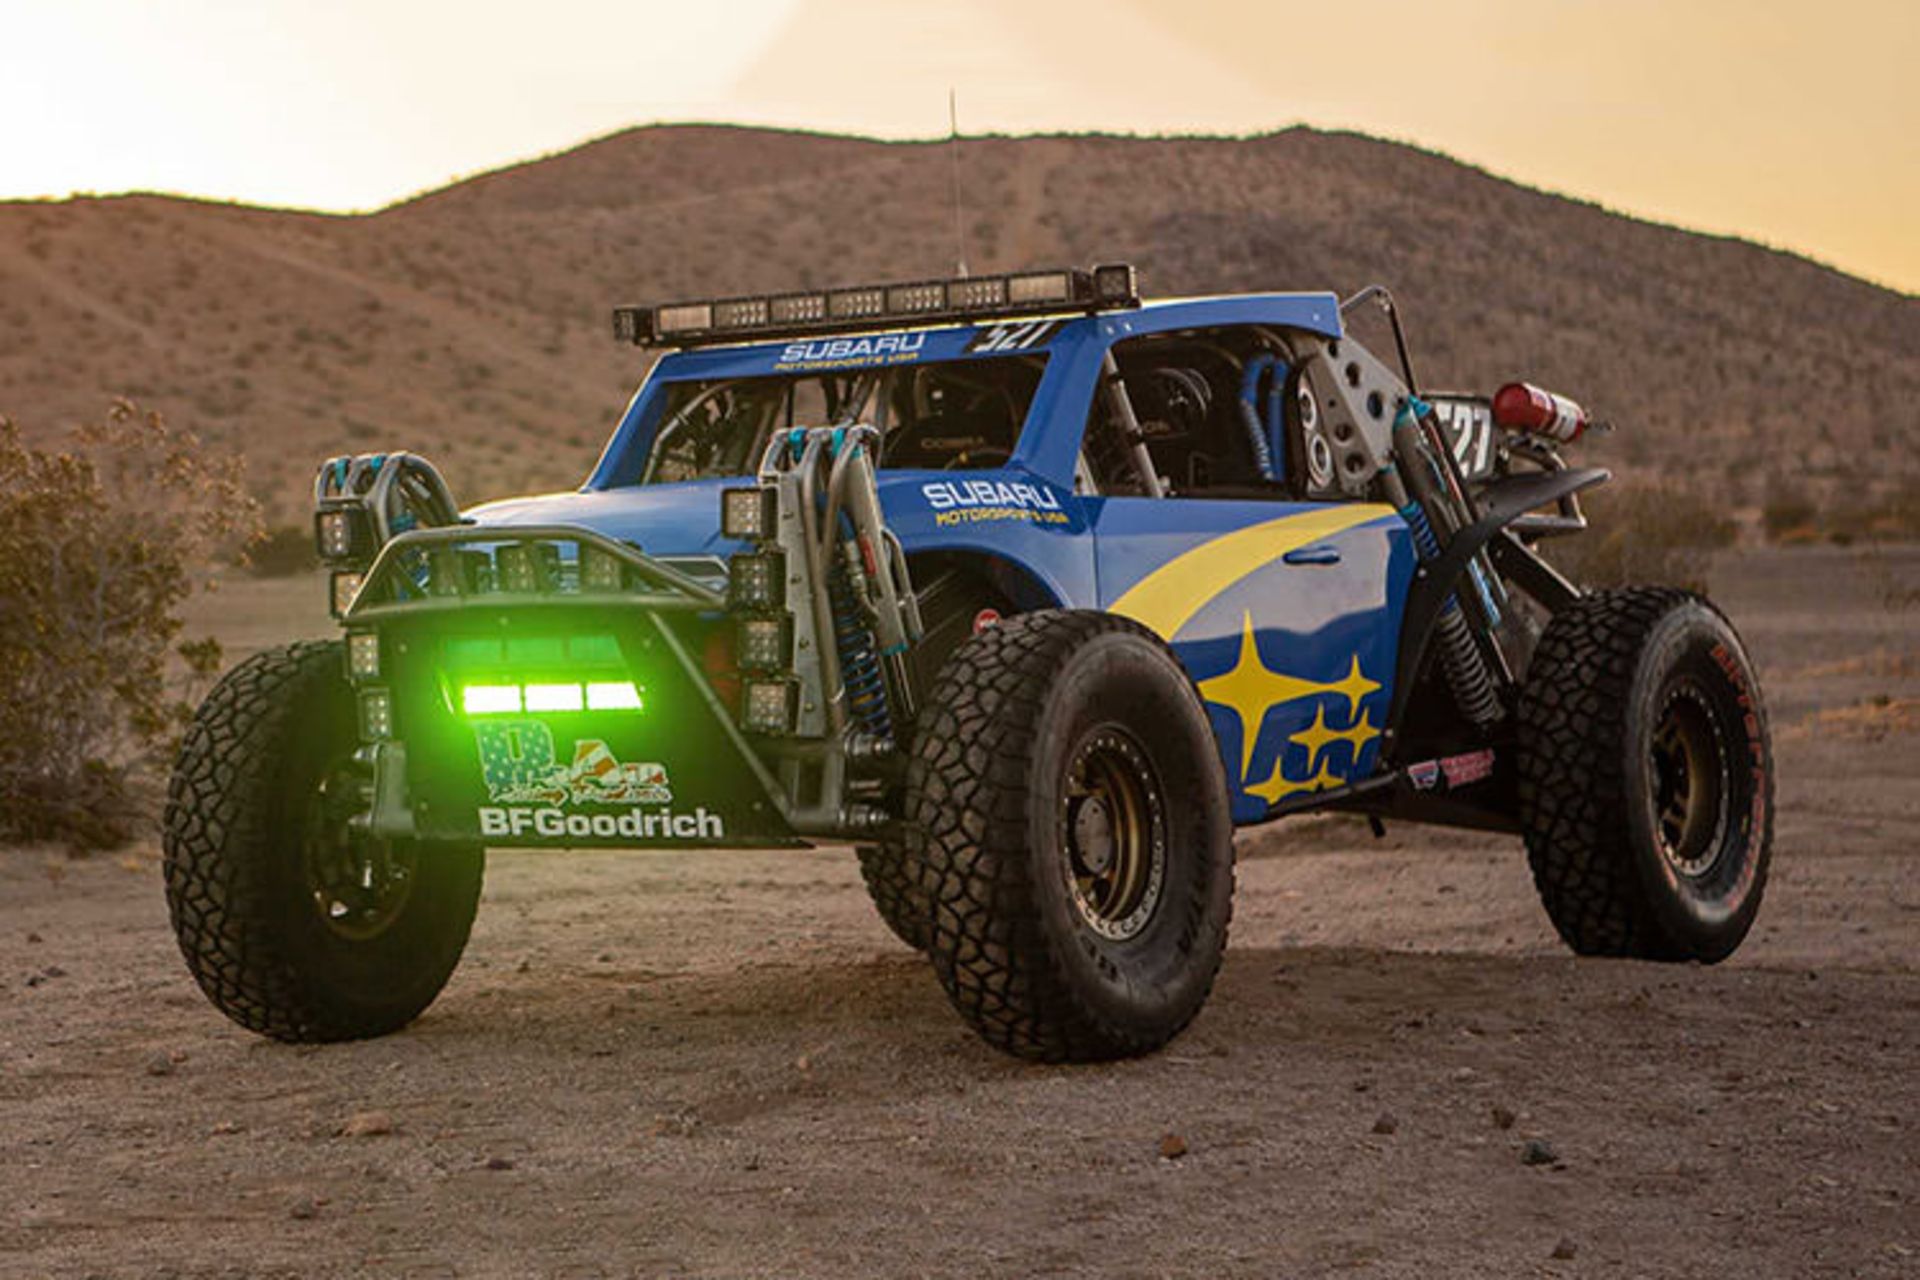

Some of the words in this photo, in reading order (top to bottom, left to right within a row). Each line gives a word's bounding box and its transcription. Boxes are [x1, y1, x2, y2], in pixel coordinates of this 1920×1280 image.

[780, 333, 925, 361] SUBARU
[922, 480, 1059, 509] SUBARU
[478, 806, 724, 838] BFGoodrich
